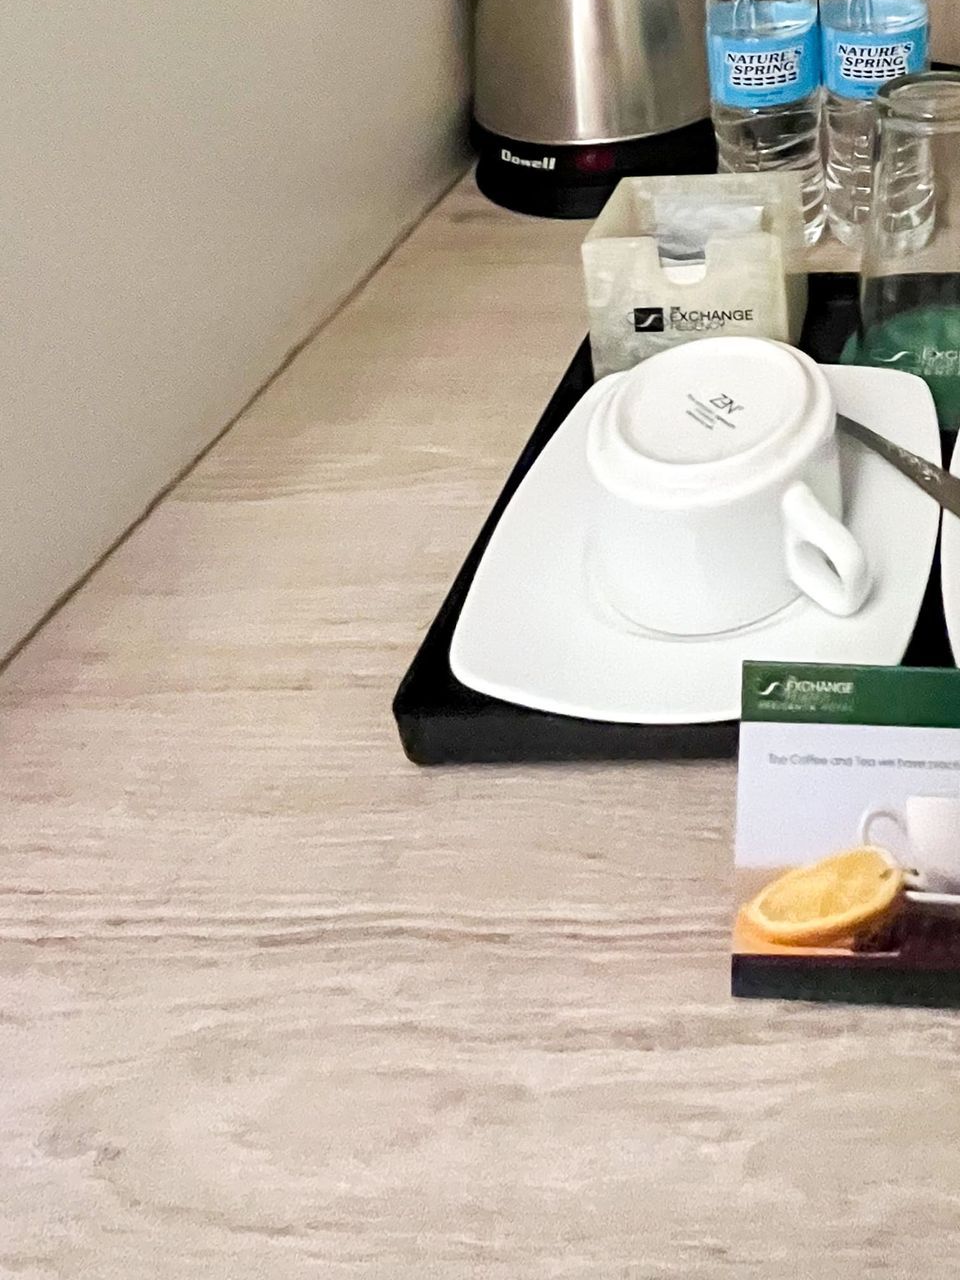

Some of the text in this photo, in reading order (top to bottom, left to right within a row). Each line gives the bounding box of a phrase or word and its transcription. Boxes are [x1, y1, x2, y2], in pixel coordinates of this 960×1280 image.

[838, 41, 912, 58] NATURE'S
[733, 60, 795, 76] SPRING
[844, 56, 904, 69] SPRING
[670, 309, 754, 322] EXCHANGE
